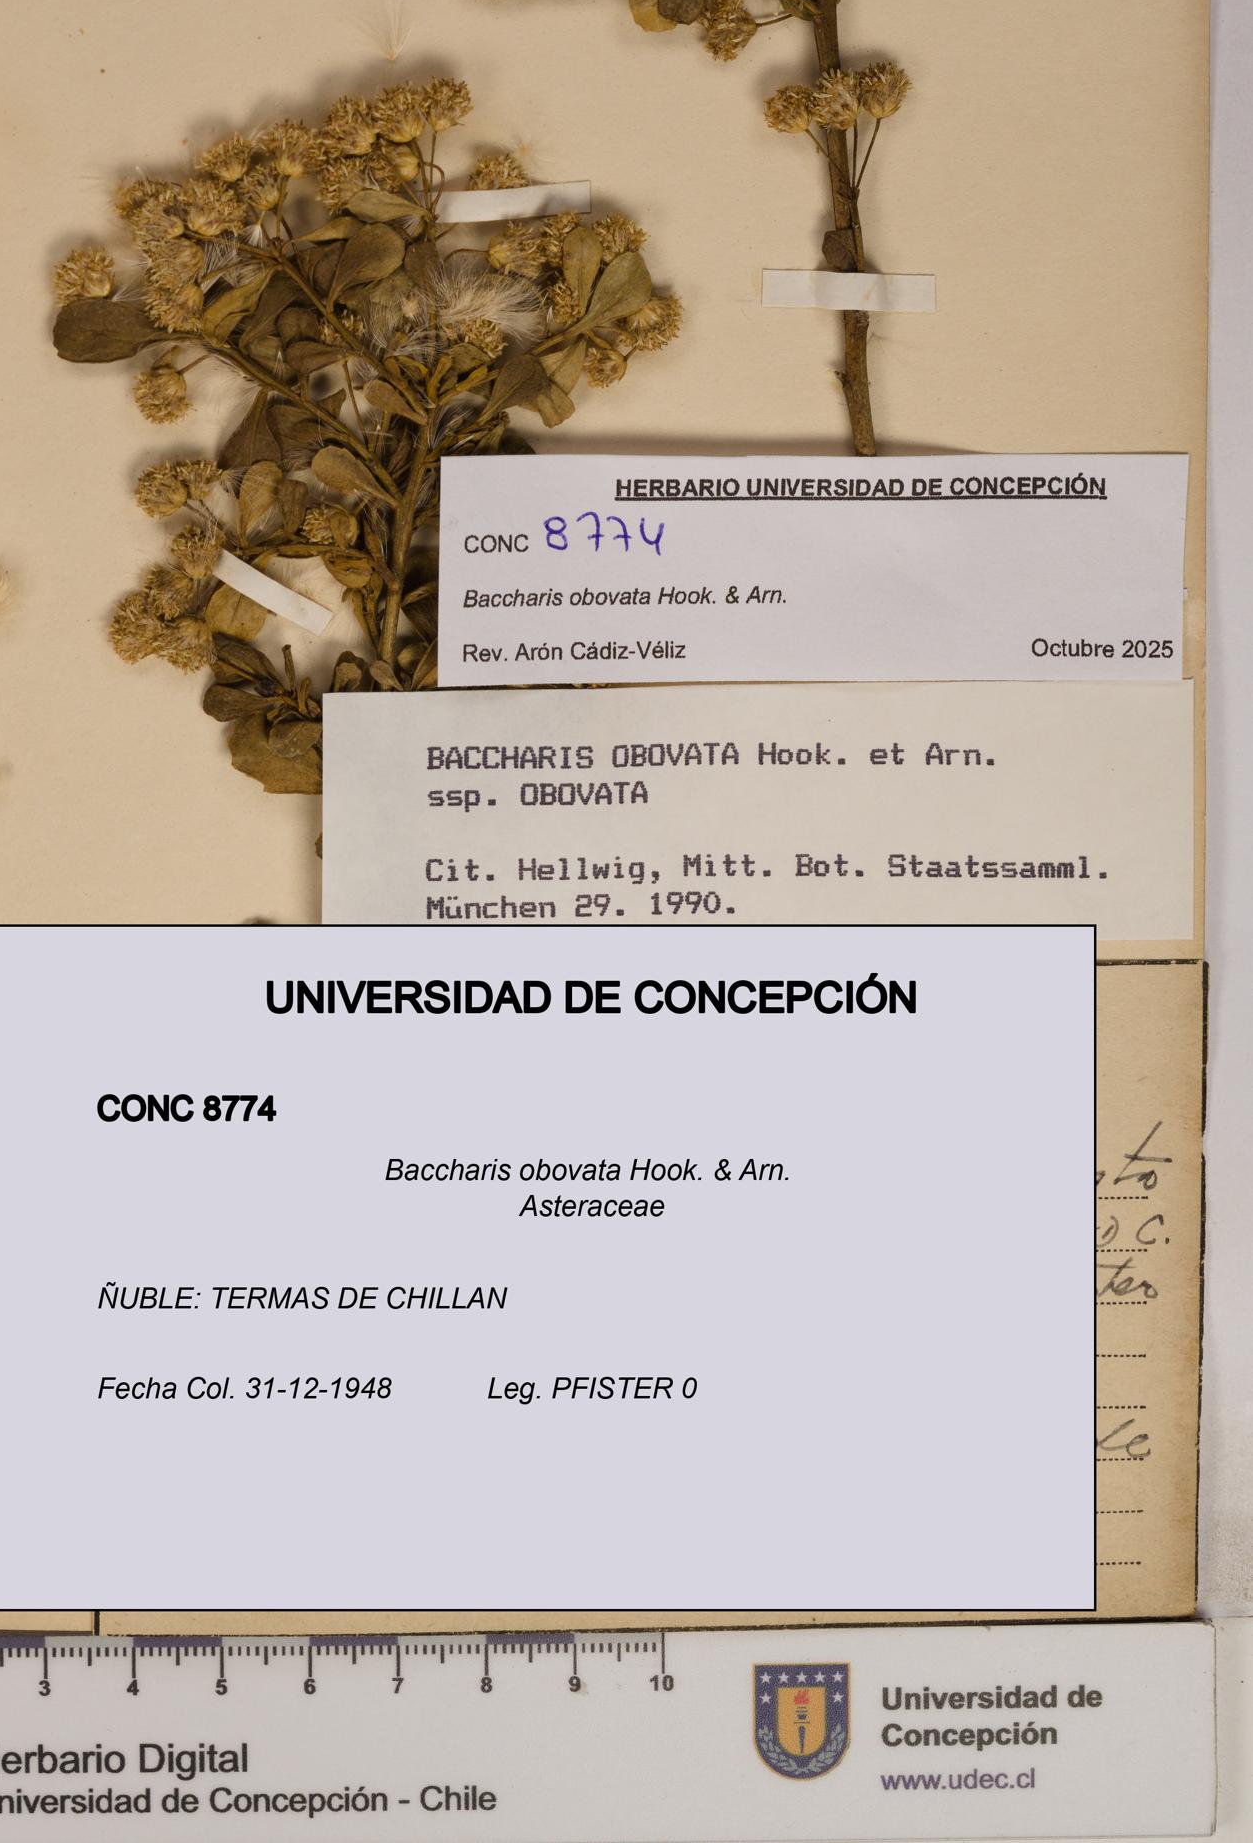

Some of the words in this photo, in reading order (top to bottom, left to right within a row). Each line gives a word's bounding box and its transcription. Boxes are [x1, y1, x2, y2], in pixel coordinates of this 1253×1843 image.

[616, 477, 740, 496] HERBARIO
[746, 478, 905, 496] UNIVERSIDAD
[911, 478, 943, 496] DE
[949, 472, 1106, 496] CONCEPCIÓN
[464, 533, 529, 554] CONC
[544, 511, 665, 554] 8774
[463, 588, 564, 608] Baccharis
[569, 587, 651, 606] obovata
[657, 586, 716, 605] Hook.
[725, 585, 740, 604] &
[745, 585, 787, 604] Arn.
[462, 643, 508, 663] Rev.
[514, 642, 563, 662] Arón
[570, 640, 686, 661] Cádiz-Véliz
[1031, 637, 1115, 658] Octubre
[1121, 639, 1174, 659] 2025
[426, 745, 594, 770] BACCHARIS
[611, 742, 740, 768] OBOVATA
[758, 742, 846, 766] Hook.
[869, 742, 905, 765] et
[925, 742, 995, 766] Arn.
[427, 789, 497, 812] ssp.
[520, 780, 649, 806] OBOVATA
[425, 858, 495, 882] Cit.
[518, 856, 660, 885] Hellwig,
[683, 853, 771, 878] Mitt.
[795, 853, 864, 878] Bot.
[887, 853, 1108, 879] Staatssamml.
[426, 895, 556, 920] München
[575, 893, 625, 918] 29.
[650, 891, 736, 916] 1990.
[38, 1680, 52, 1697] 3
[126, 1680, 140, 1696] 4
[215, 1680, 228, 1696] 5
[303, 1682, 317, 1695] 6
[392, 1681, 404, 1694] 7
[480, 1680, 493, 1694] 8
[568, 1680, 582, 1693] 9
[649, 1676, 675, 1692] 10
[882, 1684, 1058, 1711] Universidad
[1067, 1684, 1103, 1708] de
[881, 1721, 1058, 1752] Concepción
[139, 1742, 248, 1780] Digital
[880, 1767, 1035, 1791] www.udec.cl
[161, 1785, 199, 1814] de
[209, 1786, 388, 1819] Concepción
[420, 1785, 497, 1812] Chile
